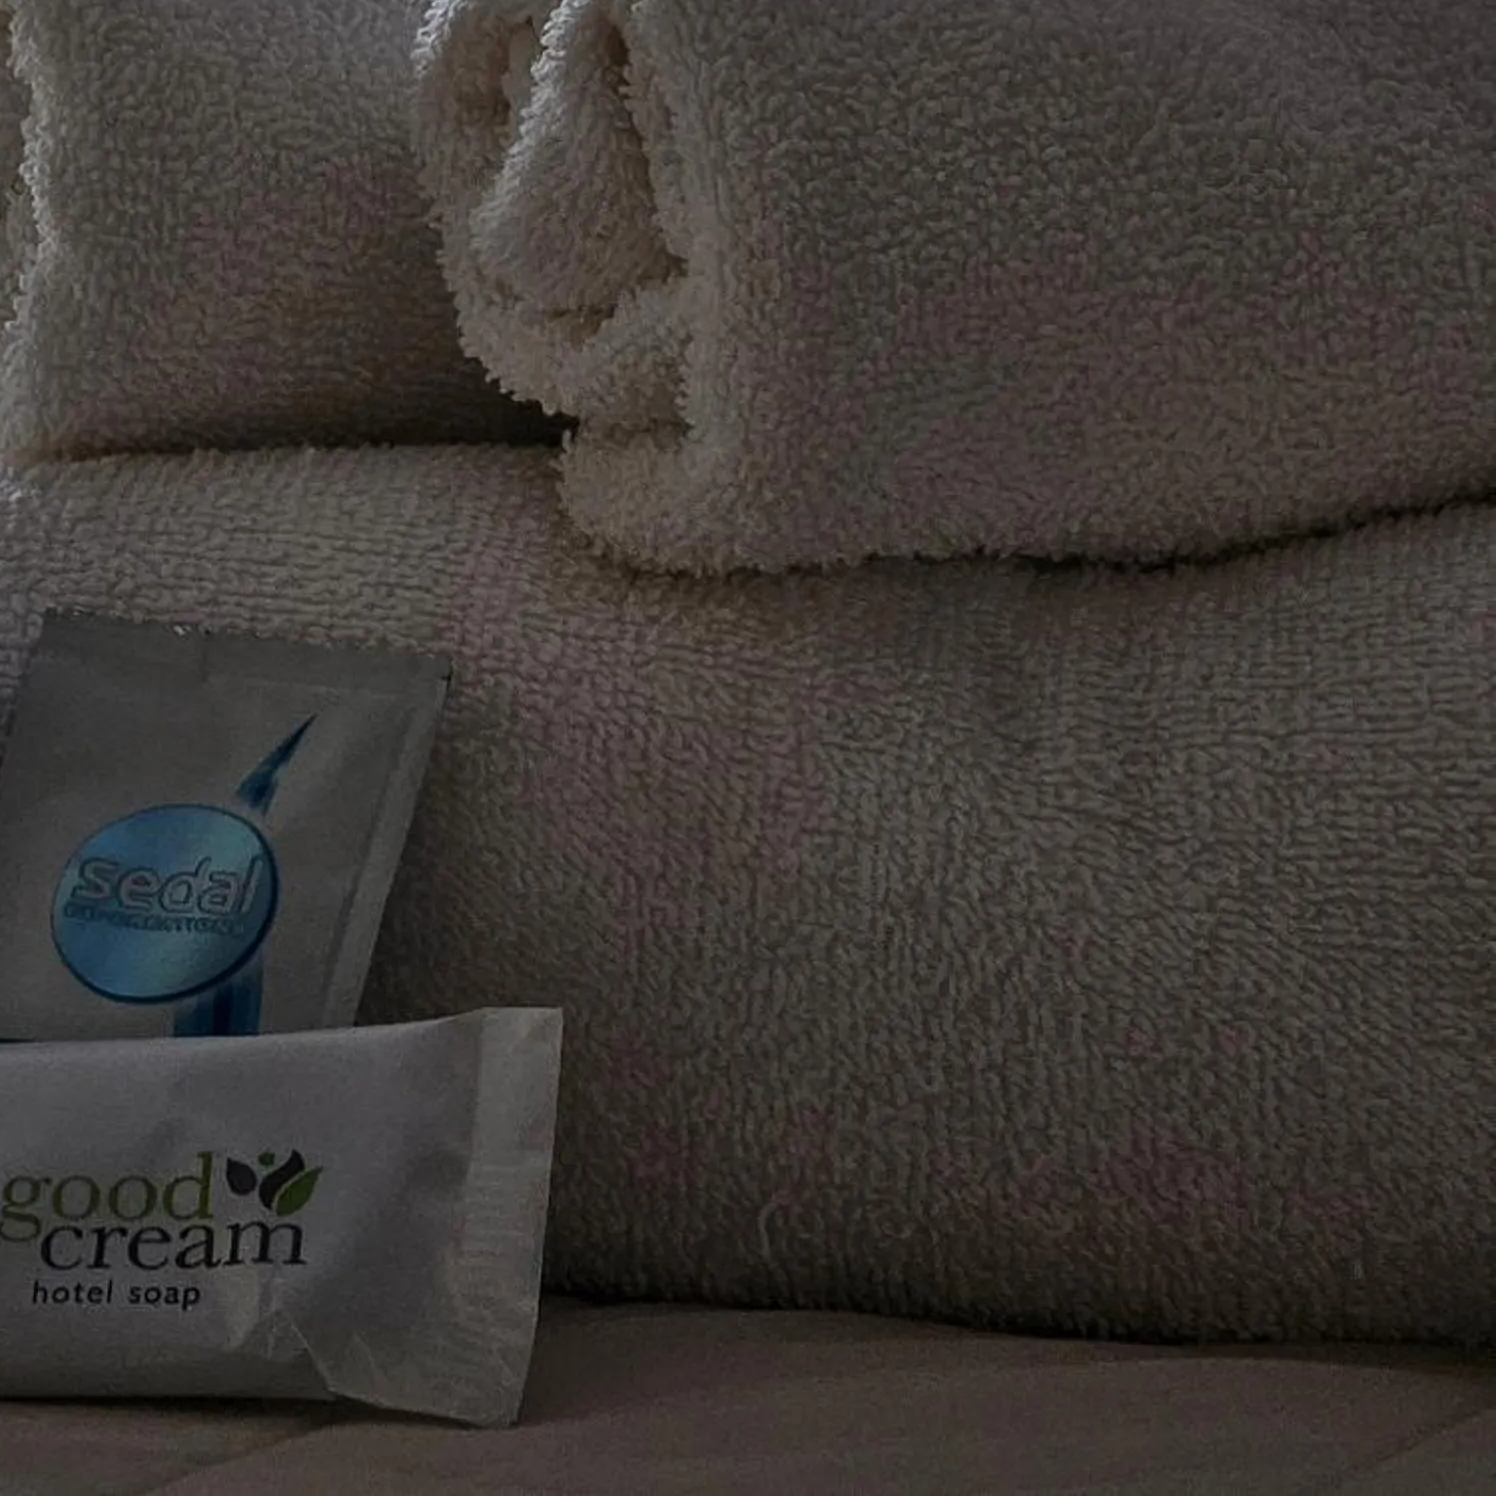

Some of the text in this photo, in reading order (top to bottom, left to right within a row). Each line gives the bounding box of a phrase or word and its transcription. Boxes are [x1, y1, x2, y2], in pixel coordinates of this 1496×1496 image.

[71, 856, 262, 915] sedal
[40, 1220, 307, 1270] cream
[32, 1280, 201, 1311] hotel soap
